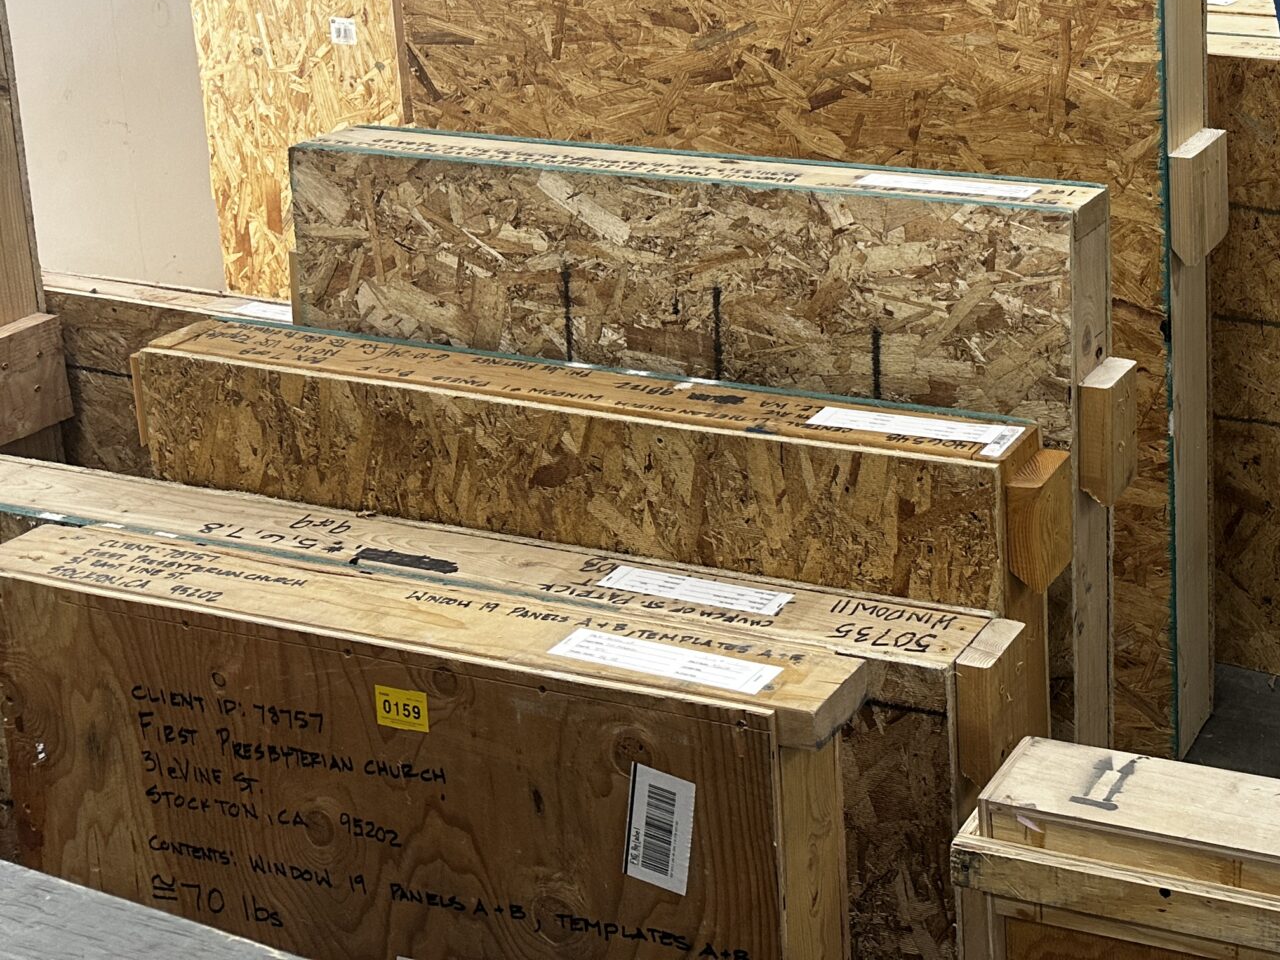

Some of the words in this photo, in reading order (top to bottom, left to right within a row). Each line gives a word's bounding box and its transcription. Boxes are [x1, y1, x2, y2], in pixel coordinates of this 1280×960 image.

[529, 387, 604, 401] WINDOW
[614, 401, 677, 414] CHURCH
[125, 563, 166, 577] VINE
[243, 572, 308, 588] CHURCH
[537, 582, 636, 606] PATRICK
[505, 604, 571, 625] PANELS
[671, 605, 695, 616] OF
[699, 609, 775, 628] CHURCH
[847, 601, 959, 631] WINDOW
[826, 622, 939, 653] 50735
[131, 685, 205, 711] CLIENT
[253, 703, 324, 734] 78757
[382, 699, 421, 720] 0159
[138, 711, 198, 745] FIRST
[364, 759, 447, 785] CHURCH
[339, 812, 403, 848] 95202
[149, 834, 237, 867] CONTENTS:
[249, 854, 332, 888] WINDOW
[350, 873, 368, 894] 19
[388, 882, 466, 912] PANELS
[555, 913, 691, 951] TEMPLATES
[241, 894, 284, 928] lbs
